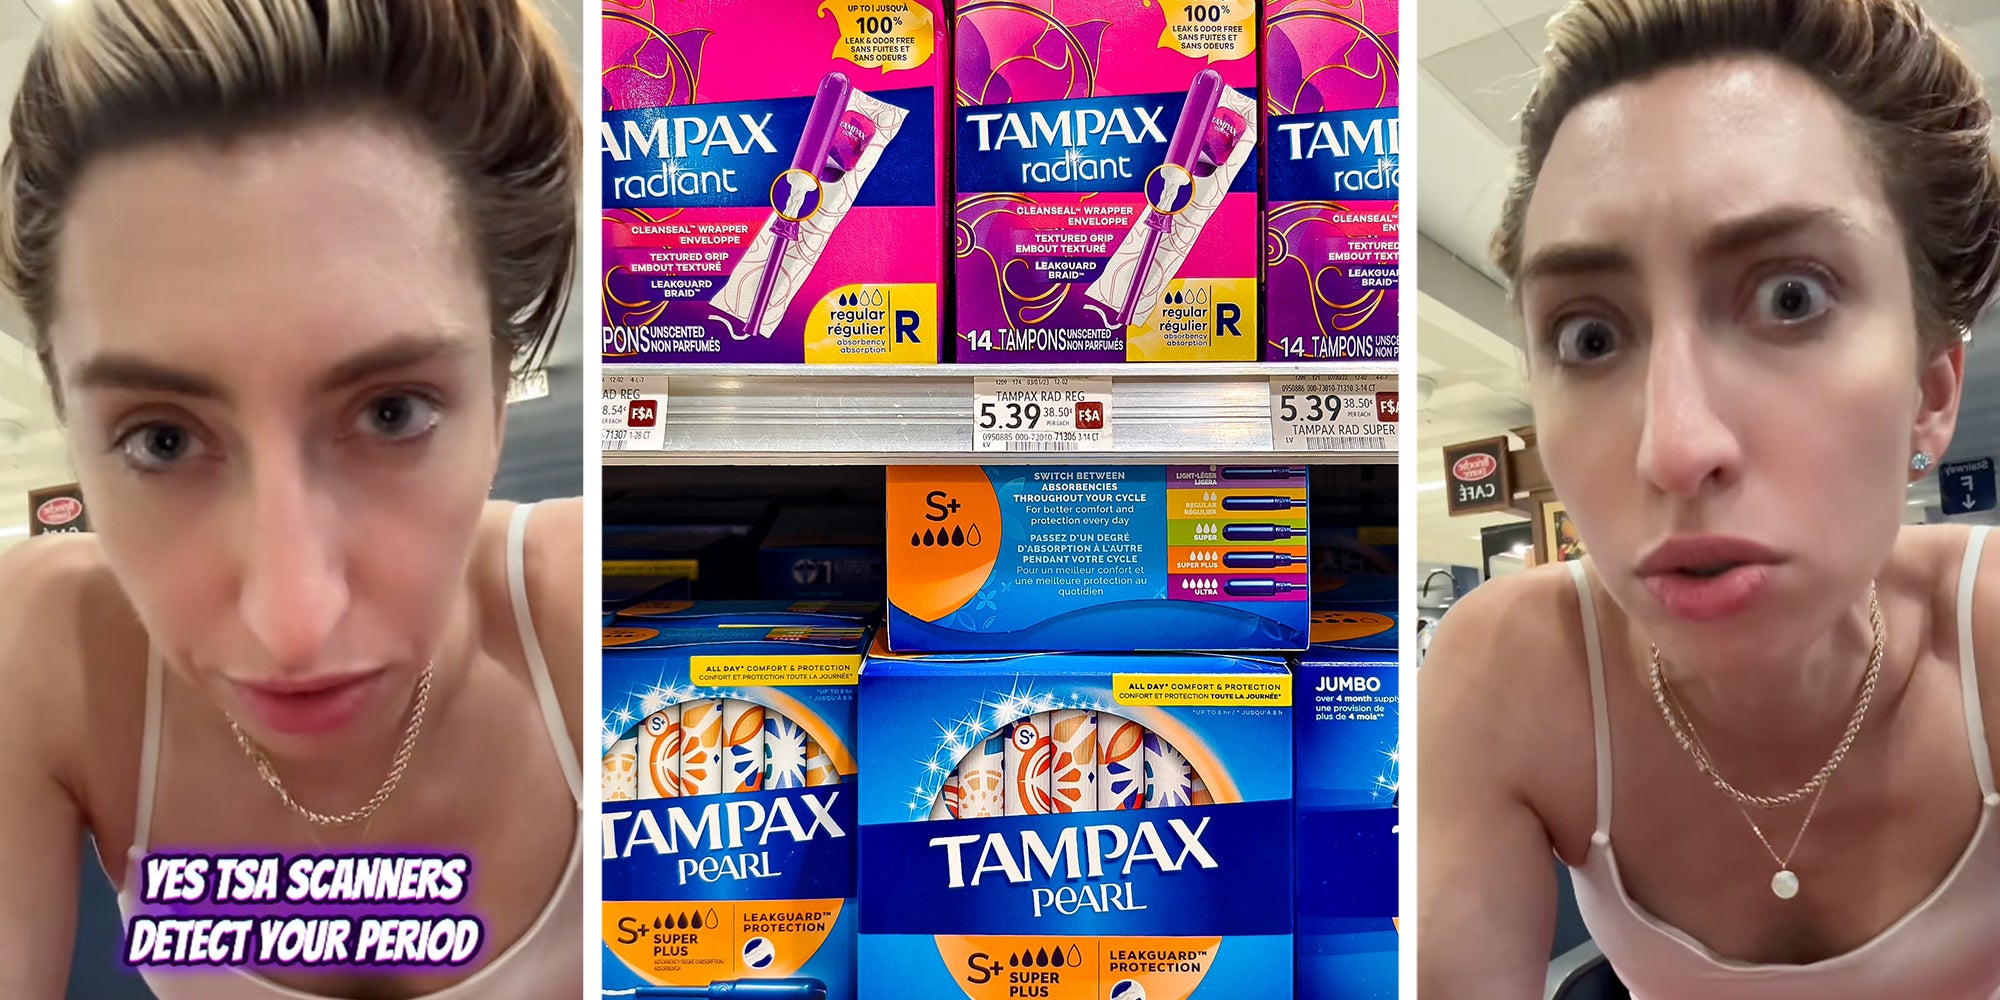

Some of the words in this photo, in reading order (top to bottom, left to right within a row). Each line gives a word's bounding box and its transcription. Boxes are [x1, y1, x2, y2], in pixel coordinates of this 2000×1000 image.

[1184, 4, 1230, 22] 100%
[856, 16, 902, 34] 100%
[966, 106, 1168, 151] TAMPAX
[1022, 149, 1132, 184] radiant
[614, 160, 738, 200] radiant
[1084, 206, 1134, 216] WRAPPER
[1068, 217, 1128, 226] ENVELOPPE
[699, 224, 748, 234] WRAPPER
[680, 236, 741, 245] ENVELOPPE
[1035, 234, 1088, 243] TEXTURED
[1090, 234, 1114, 243] GRIP
[1015, 244, 1058, 254] EMBOUT
[1060, 242, 1106, 254] TEXTURÉ
[650, 252, 702, 262] TEXTURED
[705, 252, 729, 261] GRIP
[1328, 252, 1372, 260] EMBOUT
[631, 263, 674, 272] EMBOUT
[676, 261, 722, 272] TEXTURÉ
[1035, 261, 1096, 270] LEAKGUARD
[651, 280, 712, 289] LEAKGUARD
[830, 308, 886, 322] regular
[1162, 306, 1208, 320] regular
[1216, 302, 1242, 336] R
[650, 326, 705, 338] UNSCENTED
[828, 323, 886, 337] régulier
[895, 309, 922, 344] R
[1160, 320, 1208, 333] régulier
[967, 330, 992, 351] 14
[998, 328, 1067, 351] TAMPONS
[1067, 328, 1112, 340] UNSCENTED
[651, 340, 672, 352] NON
[672, 336, 720, 352] PARFUMÉS
[836, 338, 886, 346] absorbency
[1067, 340, 1084, 351] NON
[1084, 337, 1124, 351] PARFUMÉS
[1280, 336, 1304, 358] 14
[1312, 335, 1374, 358] TAMPONS
[840, 346, 886, 354] absorption
[1375, 347, 1392, 358] NON
[620, 389, 640, 400] REG
[996, 390, 1038, 402] TAMPAX
[1040, 390, 1062, 402] RAD
[1065, 390, 1086, 402] REG
[1280, 394, 1342, 422] 5.39
[980, 403, 1041, 429] 5.39
[1078, 408, 1100, 422] F$A
[1292, 424, 1336, 435] TAMPAX
[1339, 424, 1360, 435] RAD
[1364, 424, 1396, 435] SUPER
[1034, 472, 1074, 480] SWITCH
[1076, 472, 1126, 480] BETWEEN
[1042, 483, 1118, 491] ABSORBENCIES
[1013, 494, 1084, 502] THROUGHOUT
[1086, 494, 1113, 502] YOUR
[1116, 494, 1147, 502] CYCLE
[925, 490, 961, 522] S+
[1026, 505, 1041, 514] For
[1044, 505, 1073, 514] better
[1076, 505, 1114, 514] comfort
[1116, 505, 1134, 513] and
[1030, 516, 1080, 526] protection
[1082, 518, 1110, 526] every
[1112, 516, 1130, 526] day
[1030, 534, 1067, 542] PASSEZ
[1097, 532, 1130, 542] DEGRÉ
[1018, 544, 1092, 552] D'ABSORPTION
[1102, 544, 1143, 552] L'AUTRE
[1022, 556, 1070, 564] PENDANT
[1072, 556, 1104, 564] VOTRE
[1106, 555, 1138, 563] CYCLE
[1016, 566, 1038, 574] Pour
[1056, 566, 1095, 574] meilleur
[1098, 566, 1132, 574] confort
[1036, 576, 1080, 585] meilleure
[1084, 576, 1132, 586] protection
[1058, 587, 1104, 597] quotidien
[1316, 676, 1381, 692] JUMBO
[1334, 704, 1372, 713] provision
[652, 716, 666, 730] S+
[1019, 730, 1035, 744] S+
[601, 792, 846, 859] TAMPAX
[929, 816, 1218, 889] TAMPAX
[617, 916, 650, 945] S+
[744, 922, 826, 933] PROTECTION
[654, 934, 698, 945] SUPER
[654, 946, 688, 957] PLUS
[967, 952, 1004, 984] S+
[1110, 962, 1201, 973] PROTECTION
[1009, 972, 1060, 984] SUPER
[1009, 986, 1049, 998] PLUS
